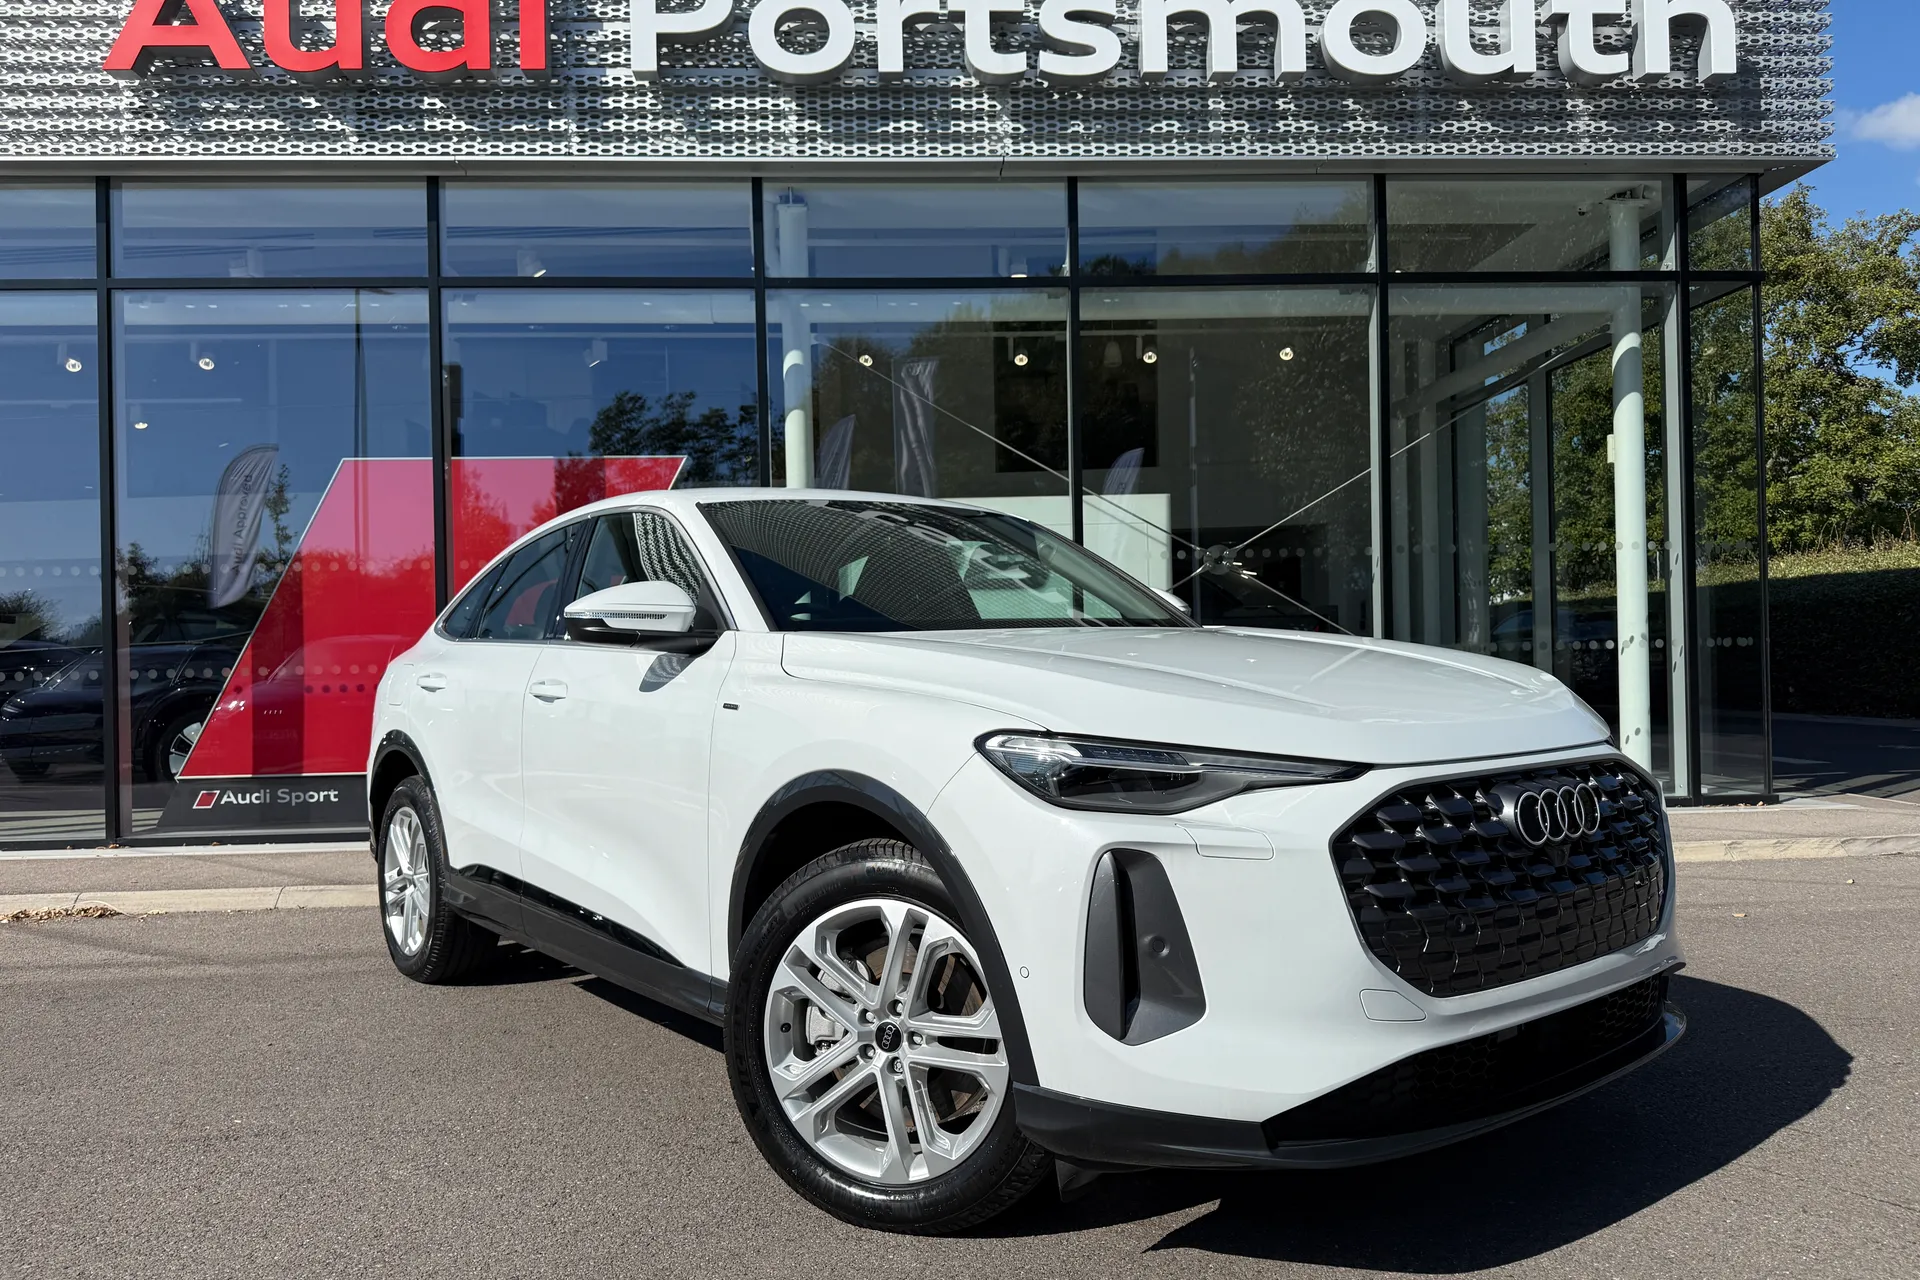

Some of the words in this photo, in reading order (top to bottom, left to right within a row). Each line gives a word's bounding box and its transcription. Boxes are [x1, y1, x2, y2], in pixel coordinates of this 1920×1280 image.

[102, 0, 547, 73] Audi
[630, 0, 1738, 76] Portsmouth
[233, 474, 253, 539] Approved
[231, 543, 244, 576] Audi
[219, 789, 271, 805] Audi
[276, 788, 339, 807] Sport
